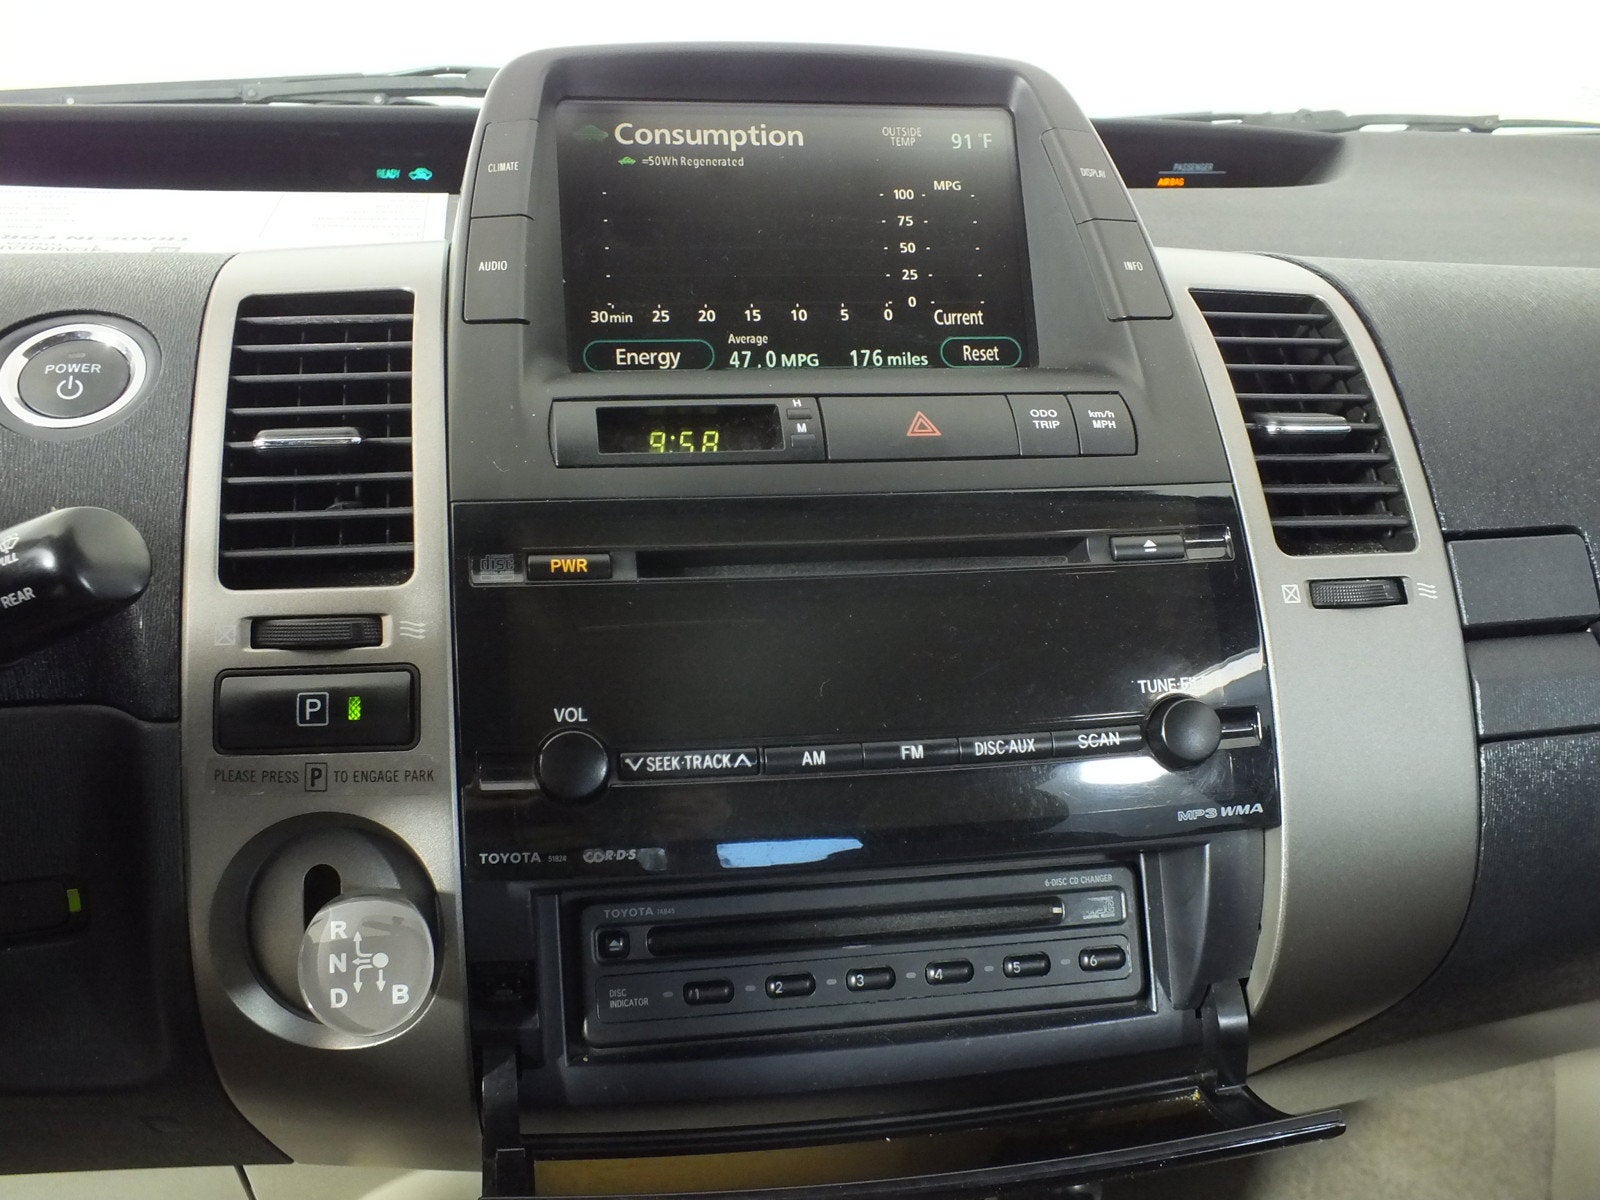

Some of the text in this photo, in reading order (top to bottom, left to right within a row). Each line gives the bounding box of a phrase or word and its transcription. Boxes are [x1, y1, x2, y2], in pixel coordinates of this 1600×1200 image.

[613, 122, 804, 151] Consumption
[882, 126, 922, 137] OUTSIDE
[890, 137, 916, 148] TEMP
[488, 162, 519, 173] CLIMATE
[680, 155, 744, 168] Regenerated
[933, 181, 962, 192] MPG
[893, 189, 914, 200] 100
[897, 215, 914, 227] 75
[899, 242, 916, 254] 50
[478, 261, 508, 271] AUDIO
[1123, 262, 1143, 271] INFO
[902, 269, 918, 281] 25
[908, 296, 917, 308] 0
[652, 310, 670, 323] 25
[698, 310, 716, 322] 20
[745, 309, 761, 322] 15
[791, 309, 808, 322] 10
[841, 309, 850, 322] 5
[884, 309, 893, 321] 0
[933, 310, 984, 326] Current
[728, 334, 768, 346] Average
[615, 348, 681, 368] Energy
[850, 349, 929, 367] 176 miles
[963, 344, 1000, 362] Reset
[781, 353, 820, 368] MPG
[44, 363, 101, 374] POWER
[793, 399, 801, 407] H
[1030, 409, 1058, 418] ODO
[1088, 409, 1115, 418] km/h
[797, 423, 807, 432] M
[1033, 420, 1060, 429] TRIP
[1093, 420, 1116, 429] MPH
[650, 431, 719, 453] 9:58
[550, 558, 588, 573] PWR
[0, 587, 36, 608] REAR
[305, 699, 321, 720] P
[554, 708, 588, 722] VOL
[1078, 731, 1120, 749] SCAN
[802, 751, 826, 766] AM
[901, 745, 924, 760] FM
[214, 769, 257, 783] PLEASE
[262, 769, 299, 783] PRESS
[334, 770, 348, 782] TO
[353, 769, 399, 782] ENGAGE
[405, 769, 434, 782] PARK
[1177, 803, 1264, 821] MP3 WMA
[479, 852, 541, 865] TOYOTA
[1069, 876, 1079, 885] CD
[1080, 874, 1113, 884] CHANGER
[603, 907, 654, 919] TOYOTA
[330, 921, 347, 940] R
[329, 953, 347, 974] N
[775, 981, 783, 994] 2
[856, 974, 865, 987] 3
[934, 968, 943, 980] 4
[1013, 961, 1021, 973] 5
[1090, 954, 1097, 967] 6
[330, 988, 348, 1009] D
[392, 984, 410, 1005] B
[609, 988, 627, 998] DISC
[609, 997, 649, 1008] INDICATOR
